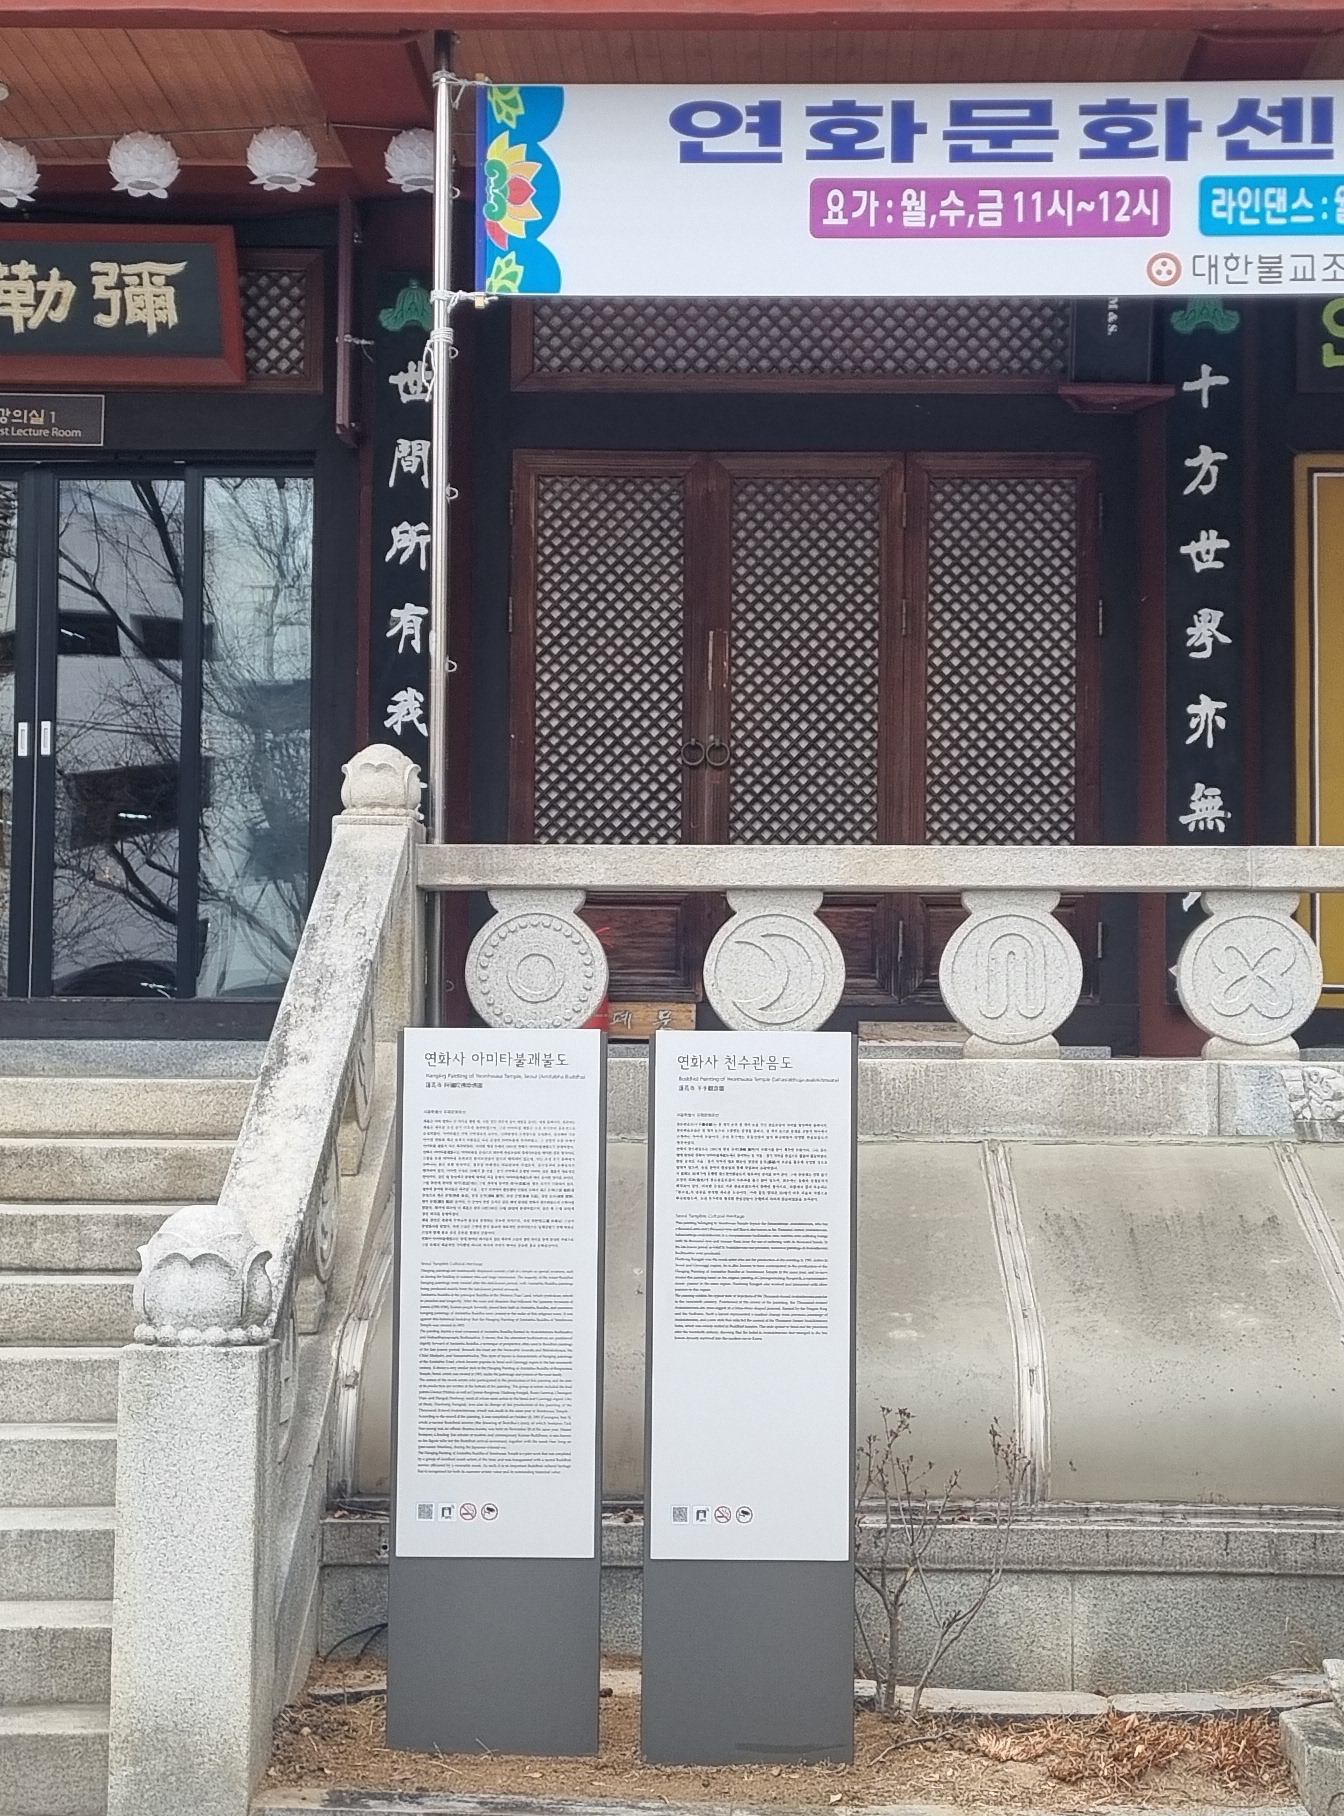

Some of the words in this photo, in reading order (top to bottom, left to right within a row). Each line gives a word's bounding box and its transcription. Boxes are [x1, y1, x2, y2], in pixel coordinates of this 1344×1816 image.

[1014, 189, 1158, 226] 11시~12시
[11, 425, 49, 438] Lecture
[52, 426, 82, 439] Room
[425, 1052, 465, 1066] 연화사
[678, 1055, 718, 1070] 연화사
[725, 1055, 793, 1070] 천수관음도
